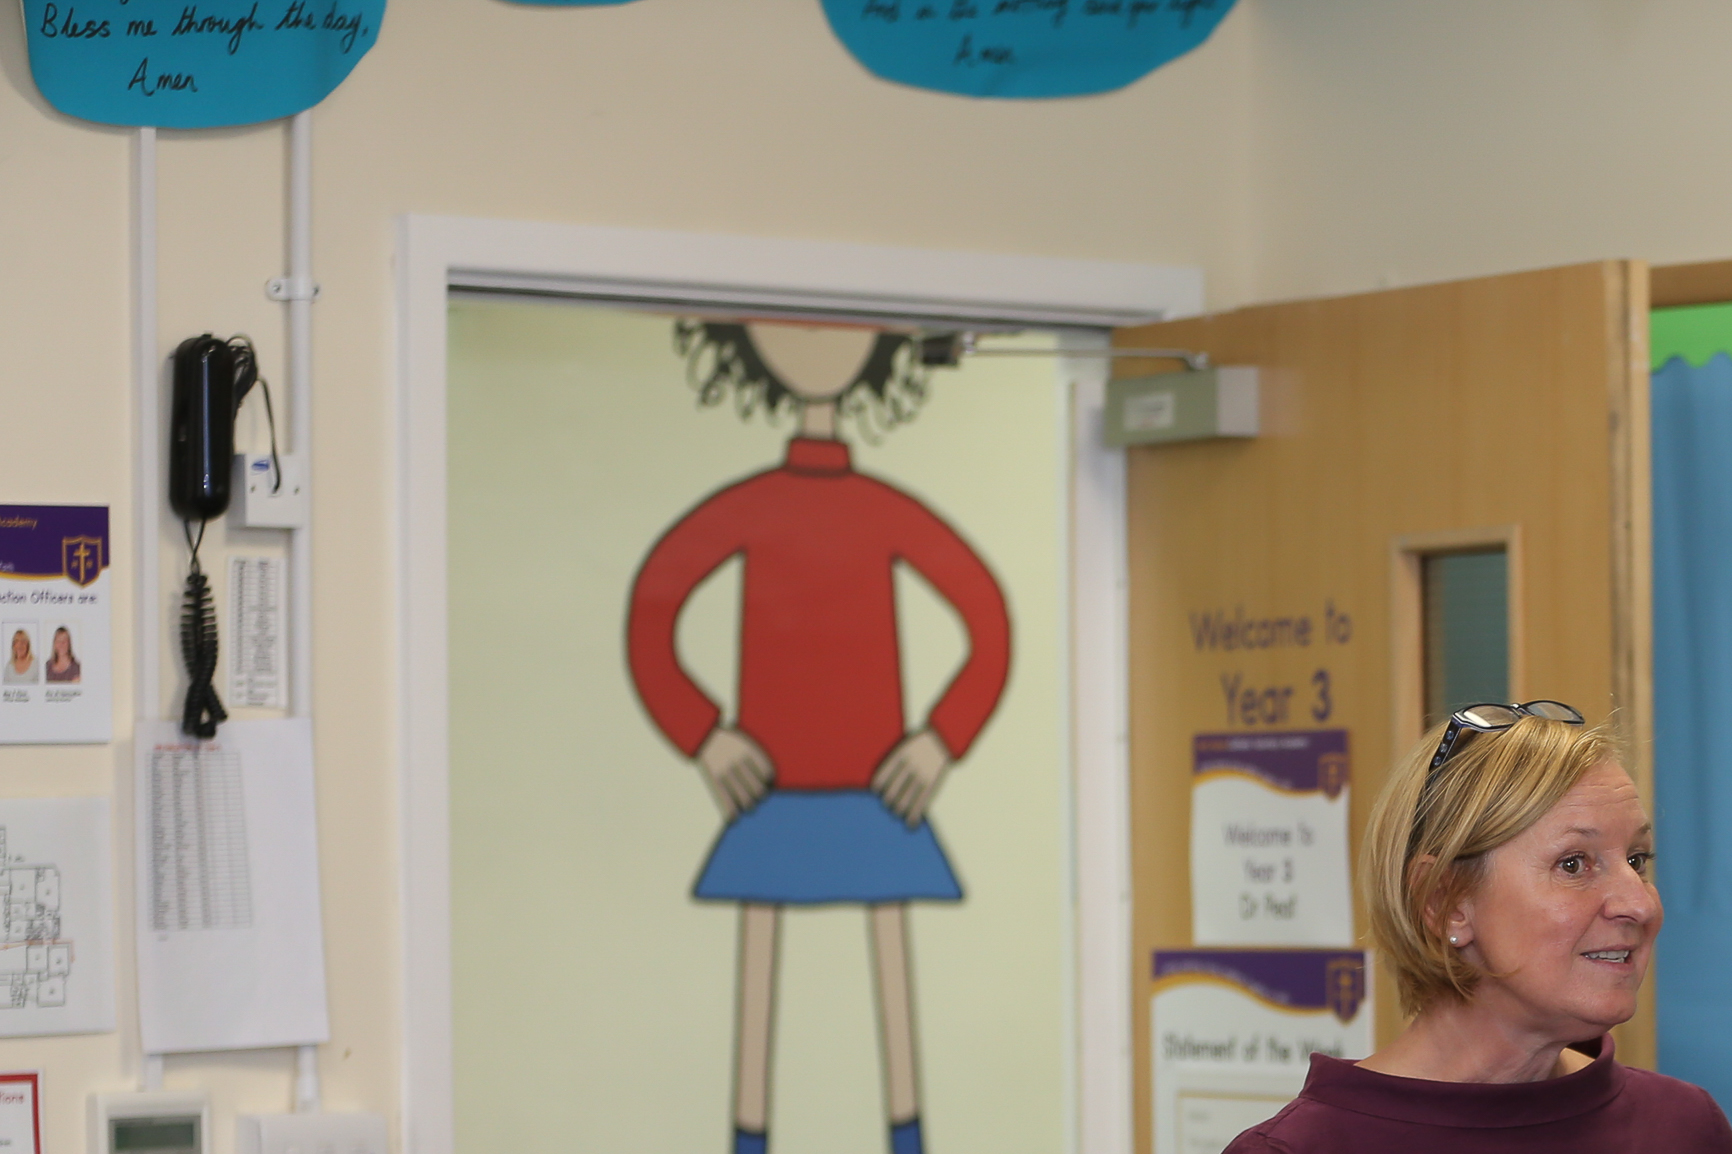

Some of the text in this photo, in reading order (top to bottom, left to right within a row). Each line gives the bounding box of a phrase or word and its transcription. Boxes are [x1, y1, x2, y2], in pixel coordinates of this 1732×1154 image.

[40, 3, 111, 38] Bless
[126, 19, 157, 37] me
[171, 6, 265, 55] through
[275, 2, 316, 31] the
[128, 57, 198, 96] Amen
[0, 515, 37, 530] cademy
[1190, 599, 1352, 652] Welcome to
[1222, 669, 1333, 726] Year 3
